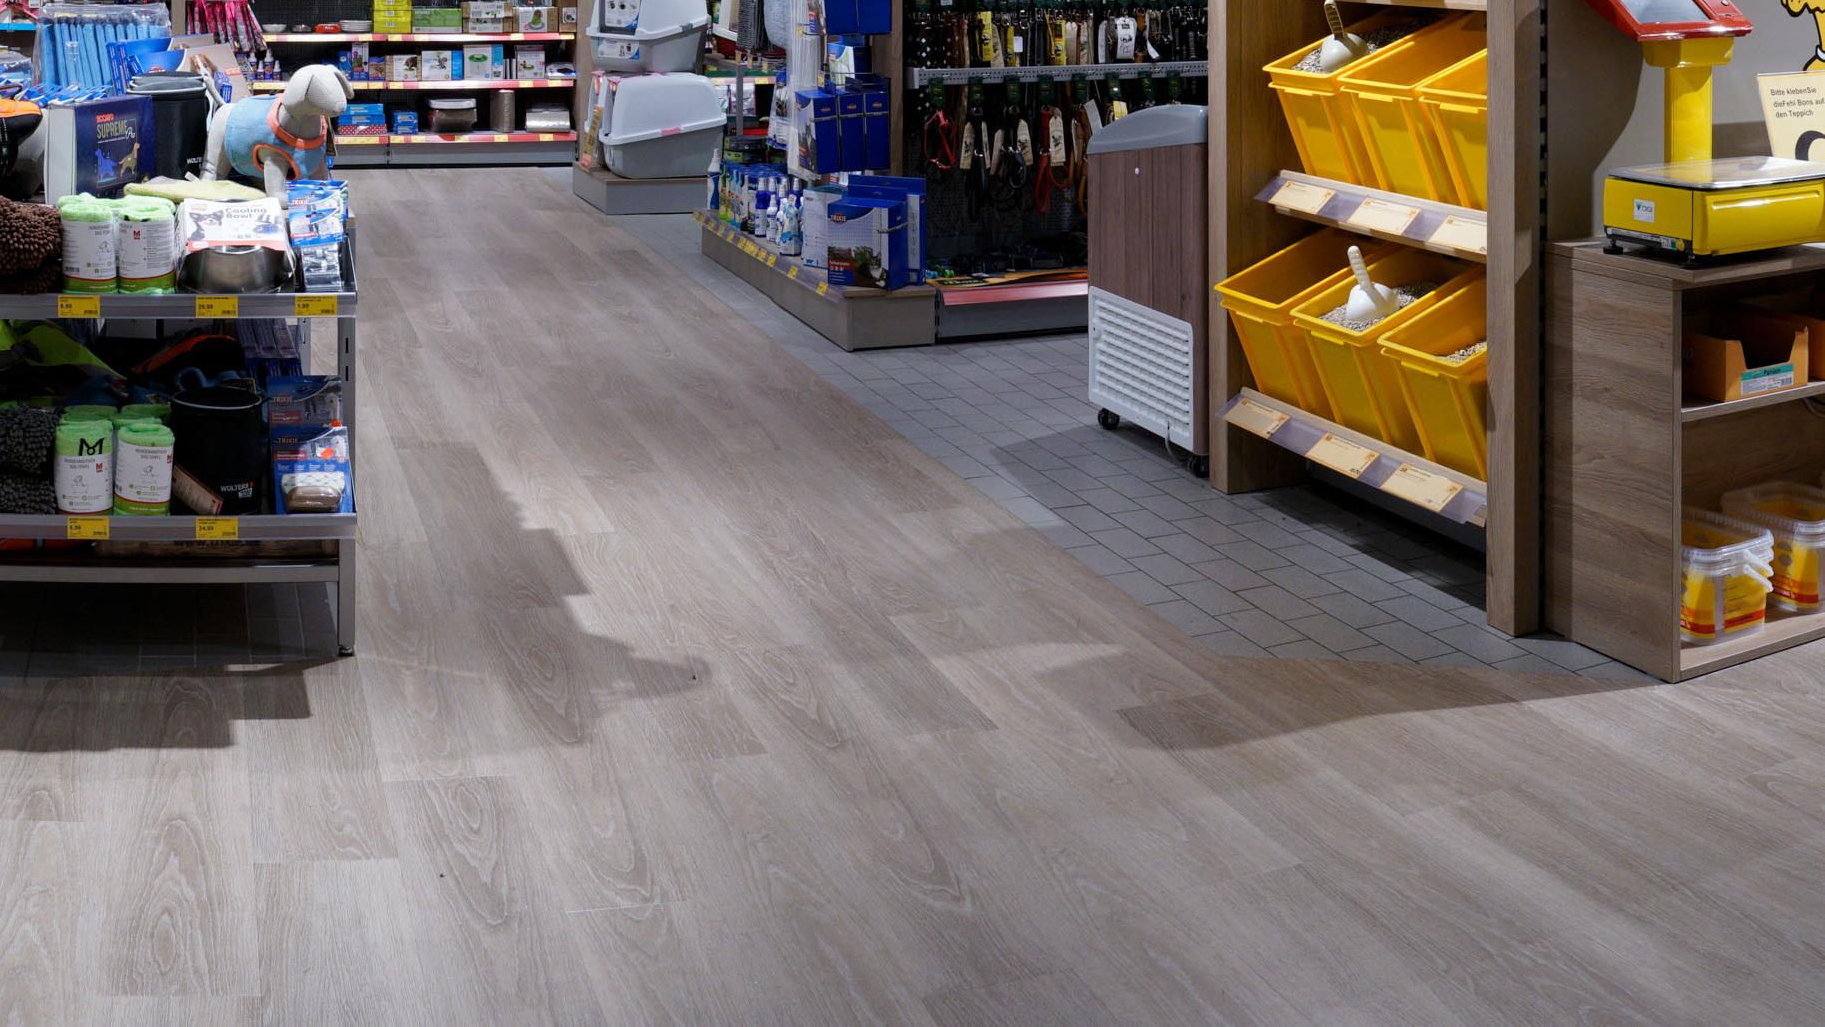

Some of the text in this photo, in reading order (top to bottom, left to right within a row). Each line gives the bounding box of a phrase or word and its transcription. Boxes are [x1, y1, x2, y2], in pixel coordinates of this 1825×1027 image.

[1771, 88, 1785, 96] Bitte
[1788, 109, 1814, 118] Teppich
[225, 207, 267, 215] Cooling
[220, 482, 248, 492] WOLTERS
